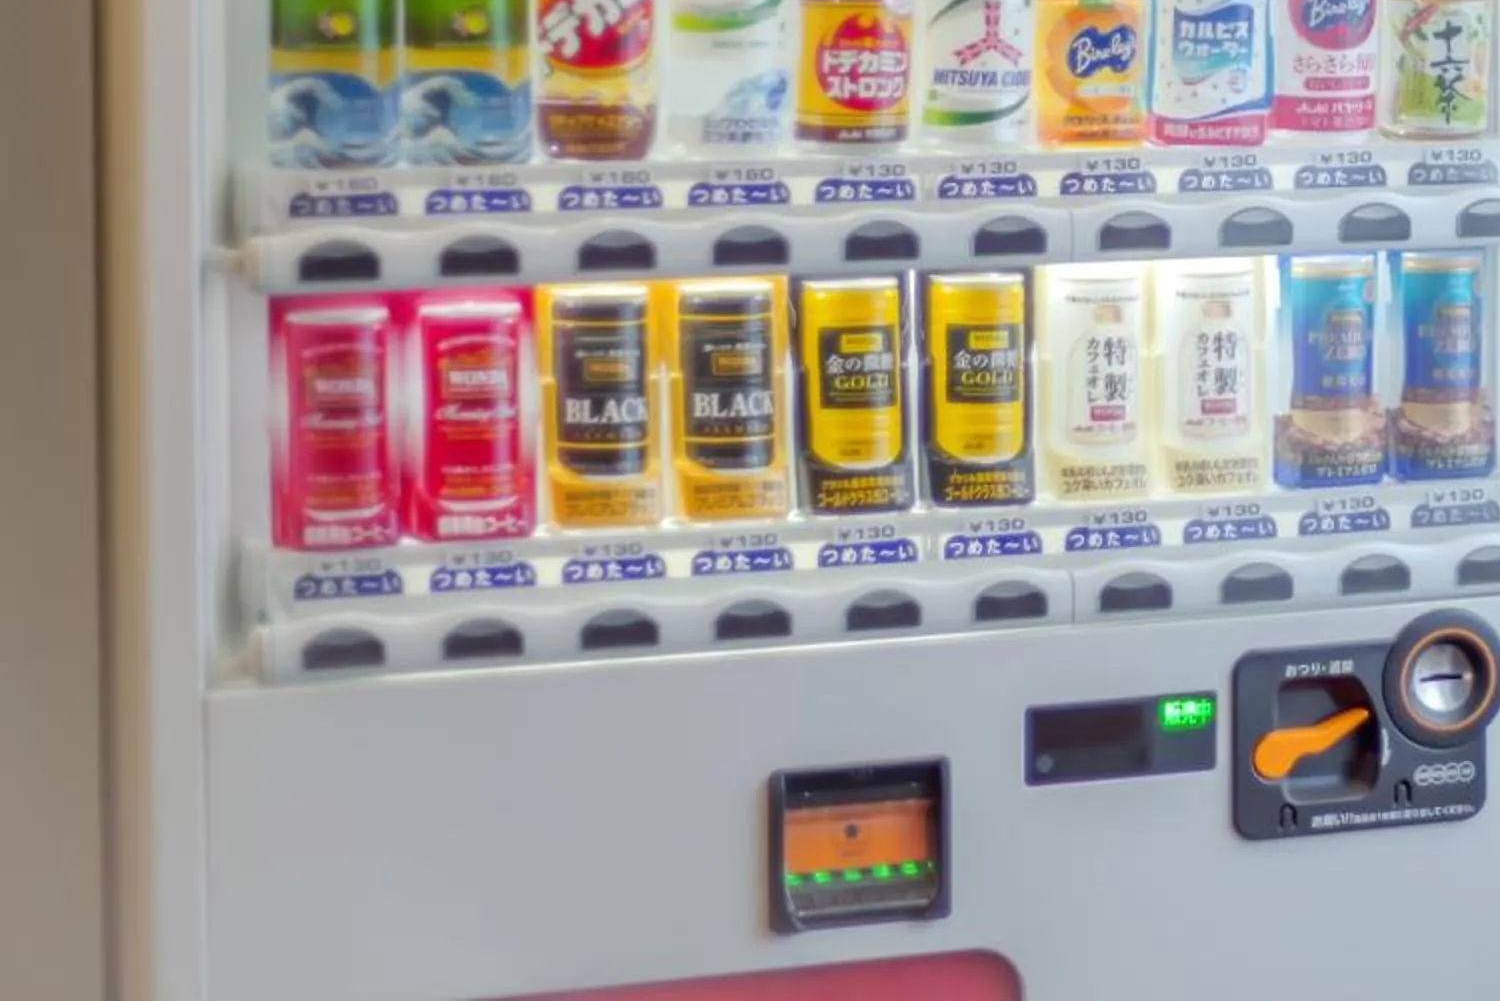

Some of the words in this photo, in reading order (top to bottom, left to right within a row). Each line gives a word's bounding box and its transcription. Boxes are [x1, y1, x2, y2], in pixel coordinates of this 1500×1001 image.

[1429, 20, 1474, 125] 十六茶
[1103, 336, 1127, 401] 特製
[1212, 330, 1238, 395] 特製
